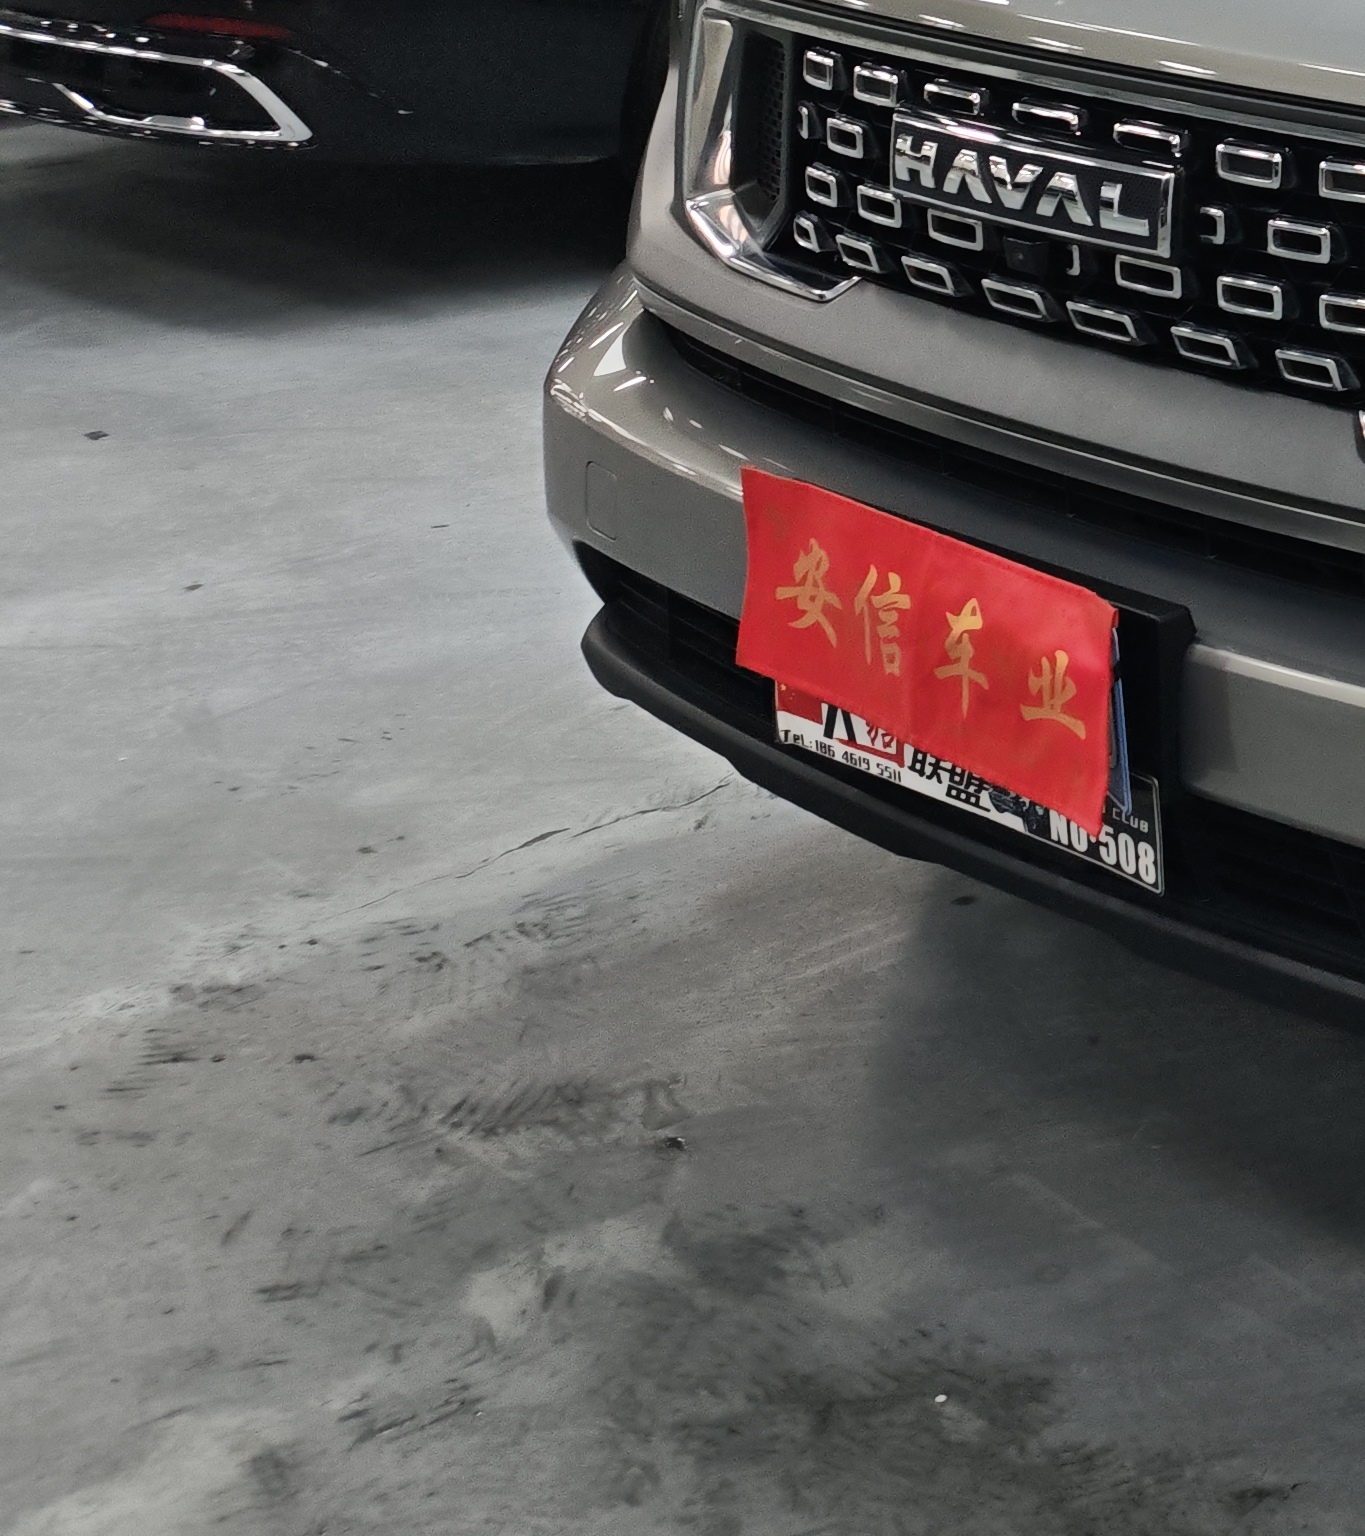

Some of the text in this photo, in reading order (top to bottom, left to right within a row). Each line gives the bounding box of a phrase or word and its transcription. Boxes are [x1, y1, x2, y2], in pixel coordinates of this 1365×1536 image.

[895, 133, 1150, 237] HAVAL
[775, 537, 1087, 740] 安信车业
